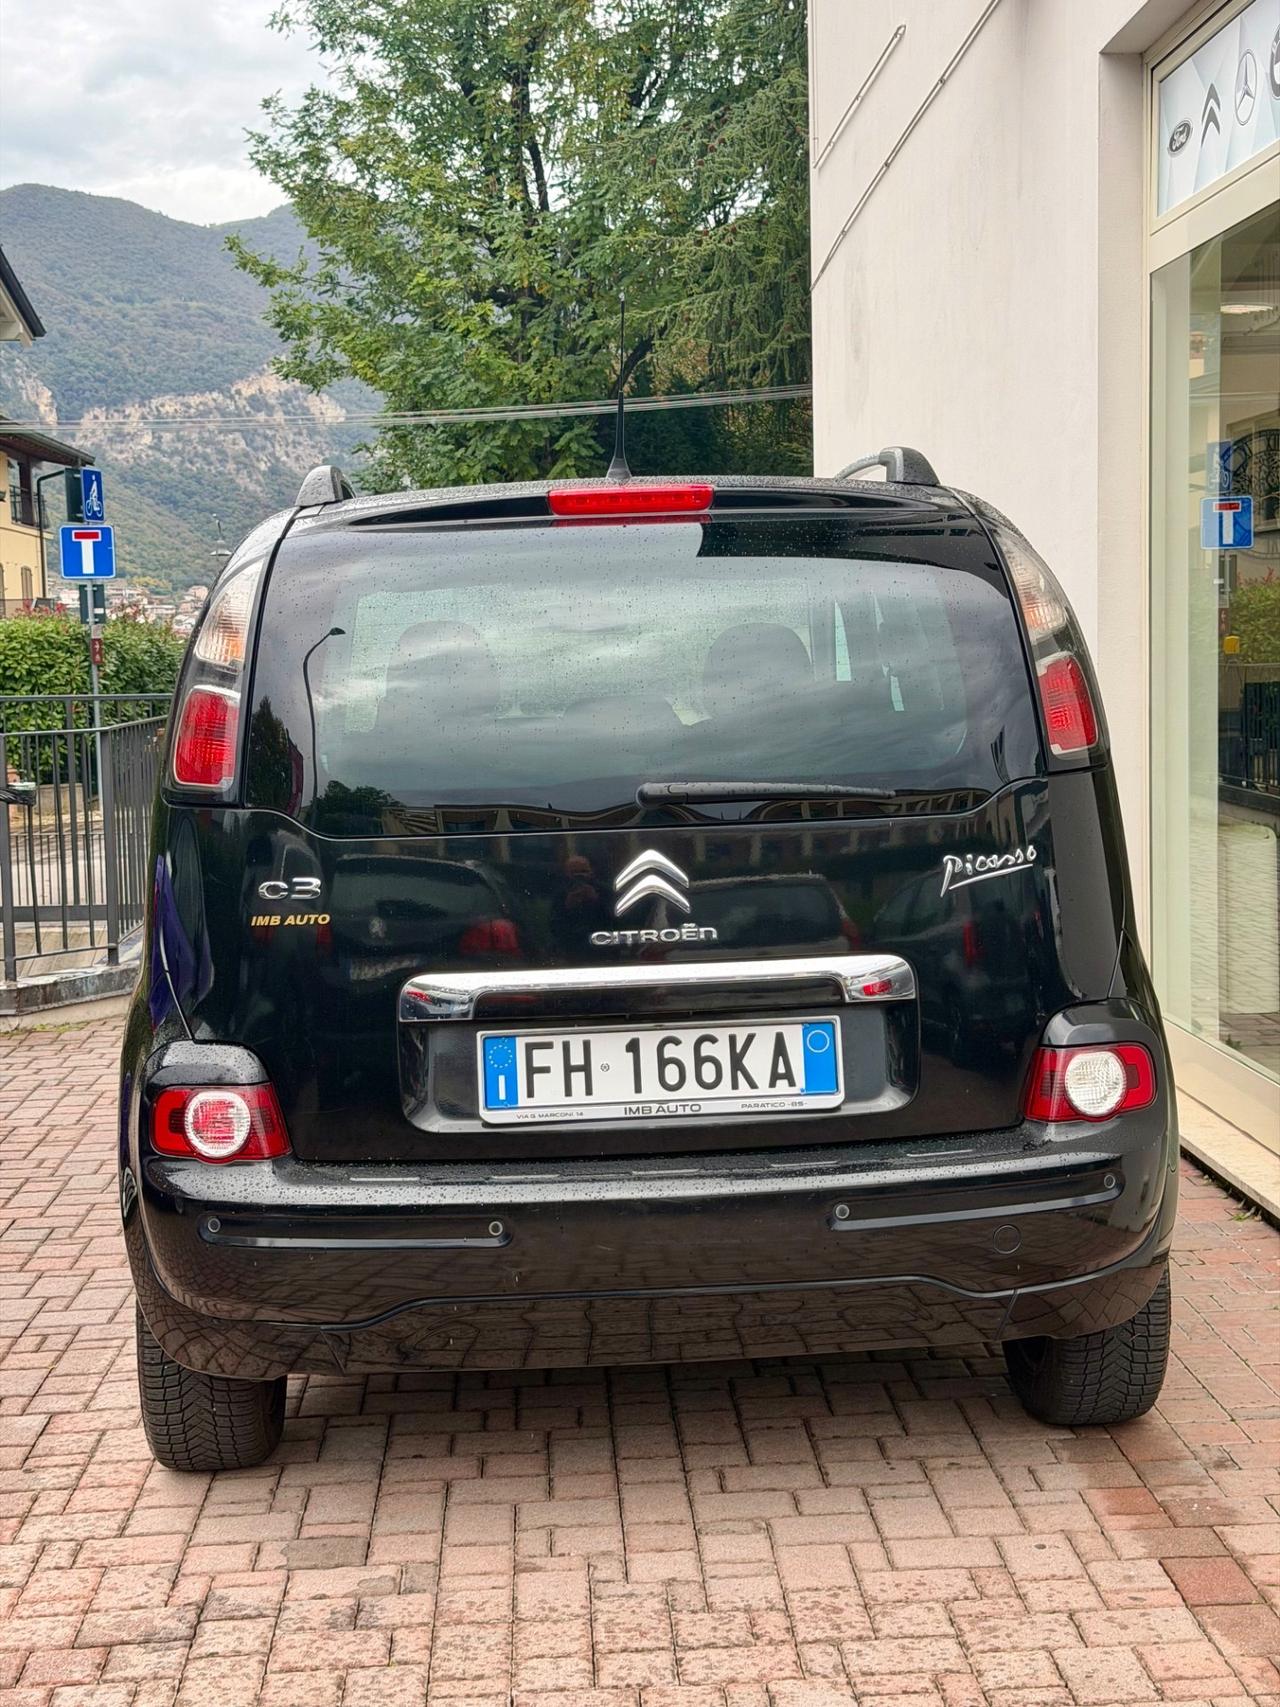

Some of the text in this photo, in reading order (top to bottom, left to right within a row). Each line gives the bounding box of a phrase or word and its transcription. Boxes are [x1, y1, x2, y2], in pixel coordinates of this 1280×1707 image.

[941, 844, 1037, 897] Picasso
[258, 877, 322, 900] C3
[251, 914, 331, 926] IMB AUTO
[524, 1031, 797, 1099] FH 166KA
[624, 1103, 702, 1116] IMB AUTO
[741, 1101, 785, 1109] PARATICO
